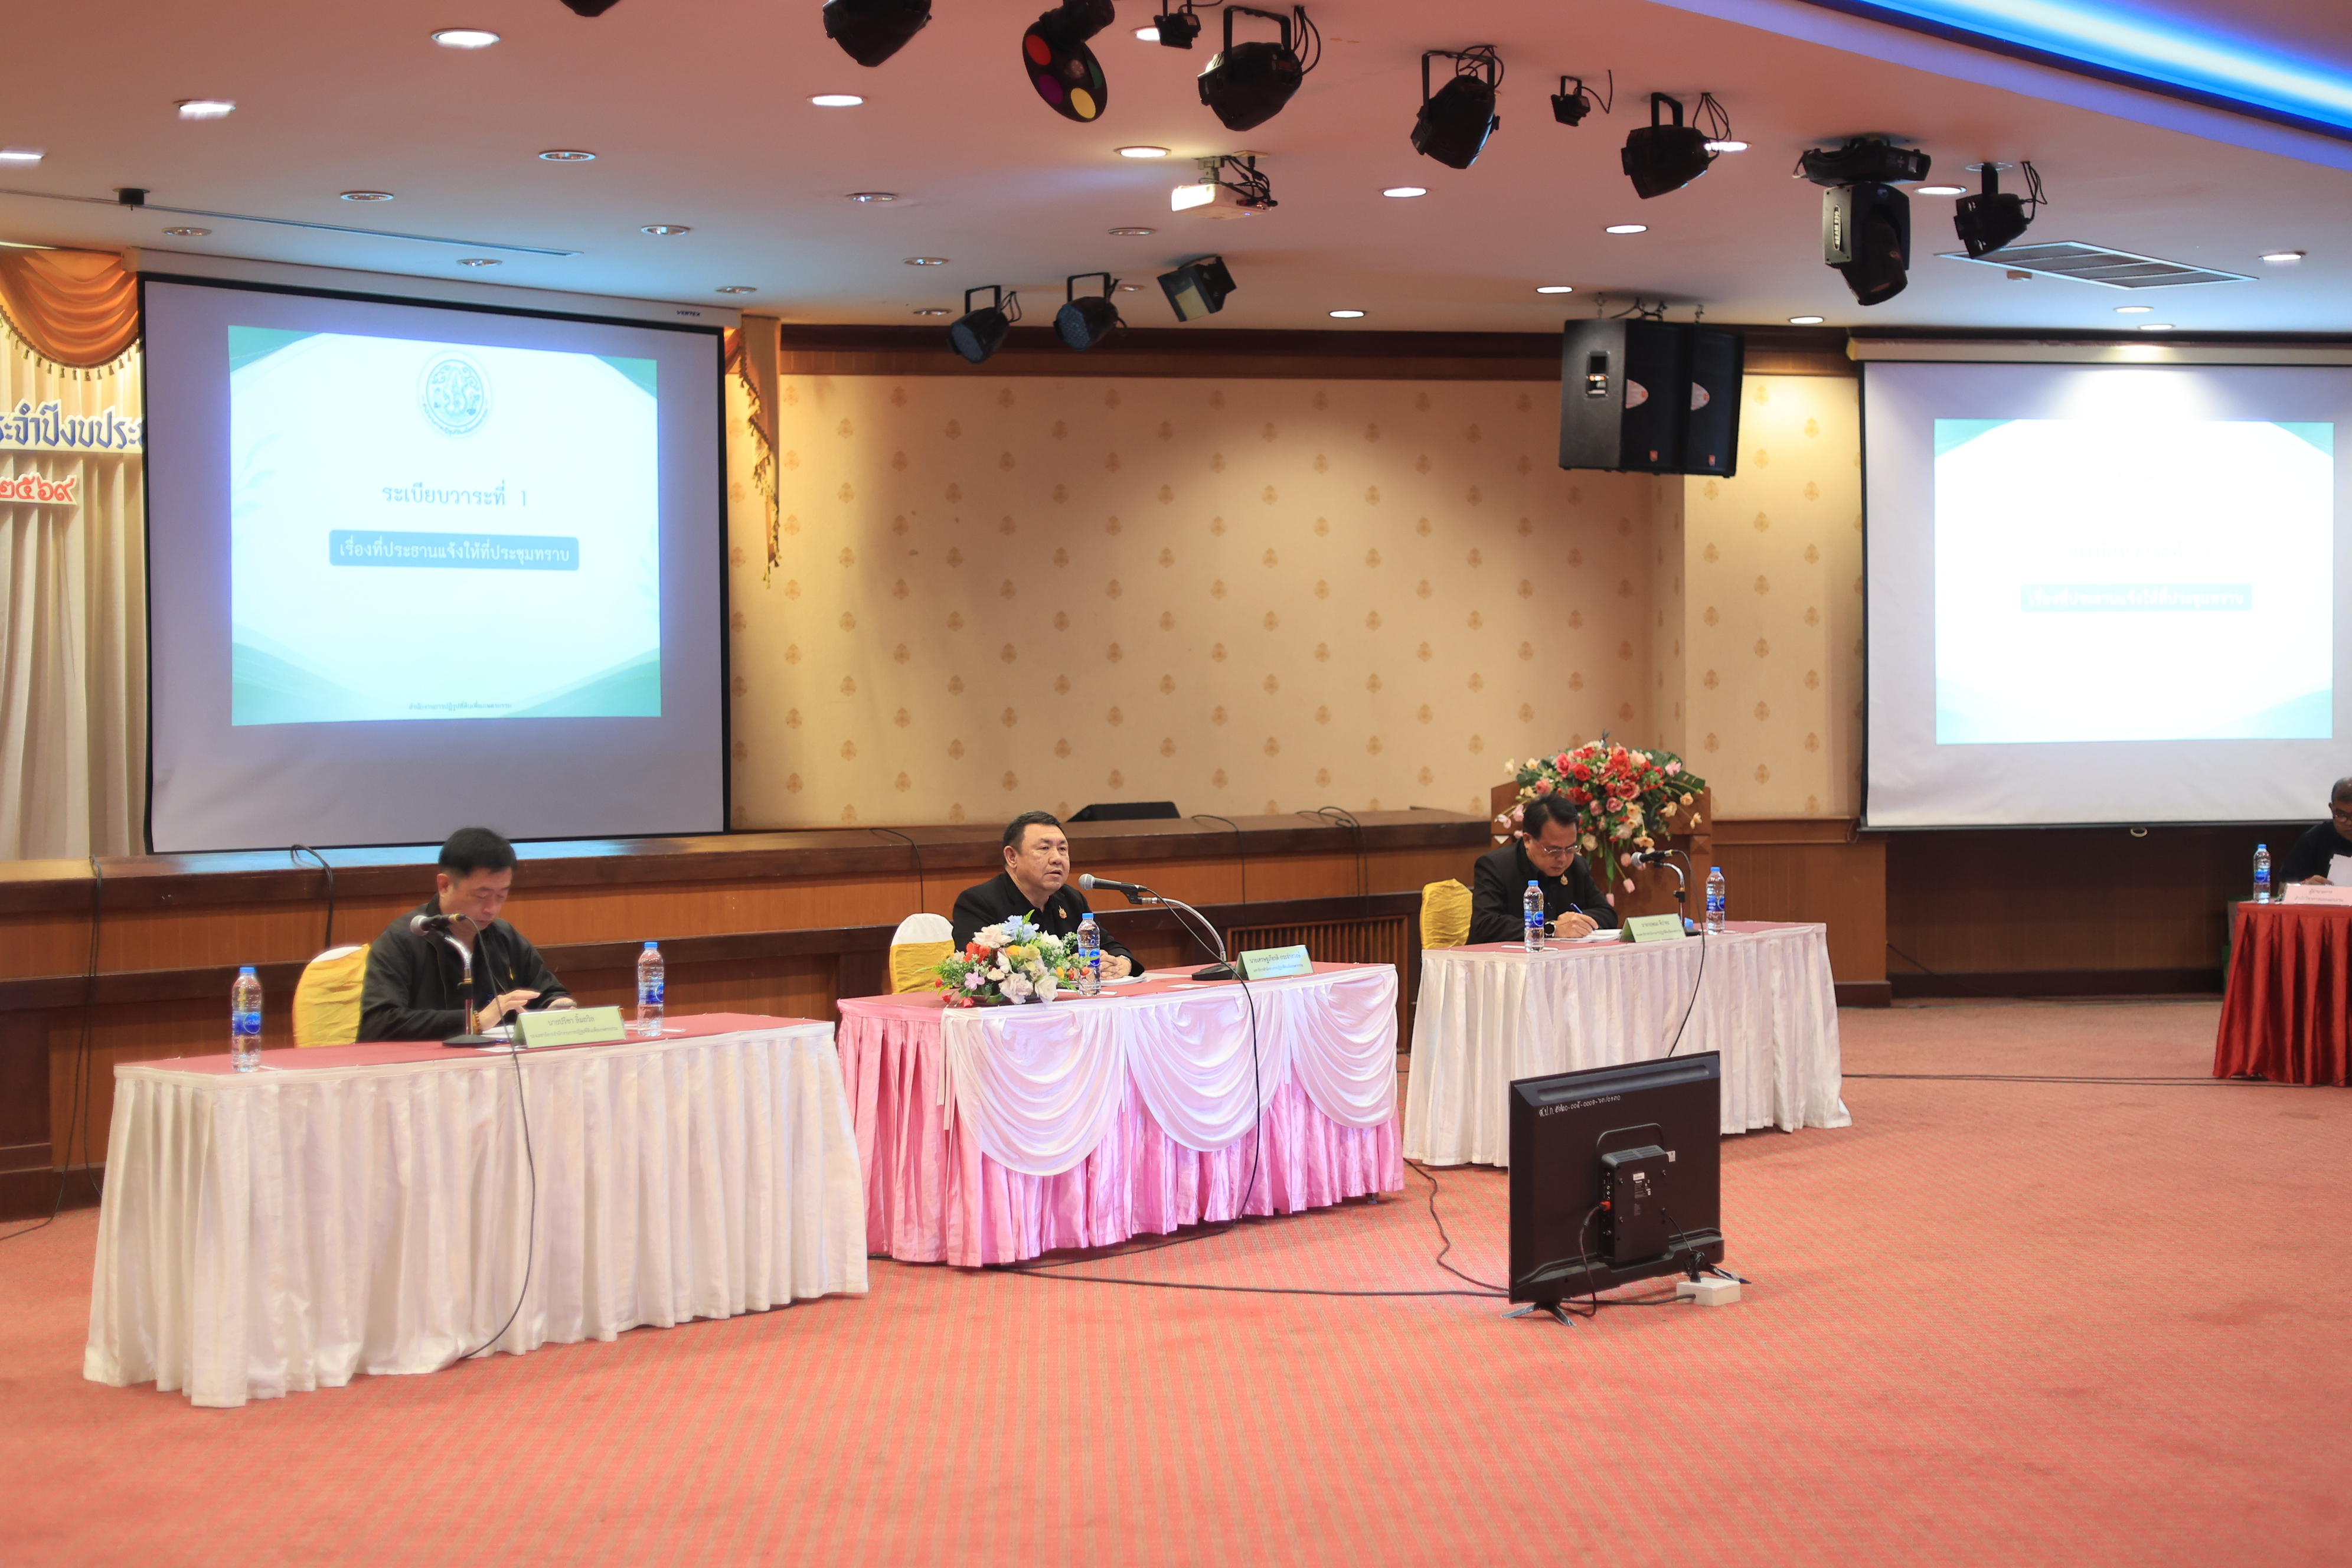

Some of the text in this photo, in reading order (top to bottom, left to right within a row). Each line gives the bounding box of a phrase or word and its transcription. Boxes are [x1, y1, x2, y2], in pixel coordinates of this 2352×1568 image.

[382, 479, 527, 507] ระเบียบวาระที่ 1
[339, 535, 570, 566] เรื่องที่ประธานแจ้งให้ที่ประชุมทราบ
[548, 1014, 595, 1026] นายปรีชา ลิ้มถวิล
